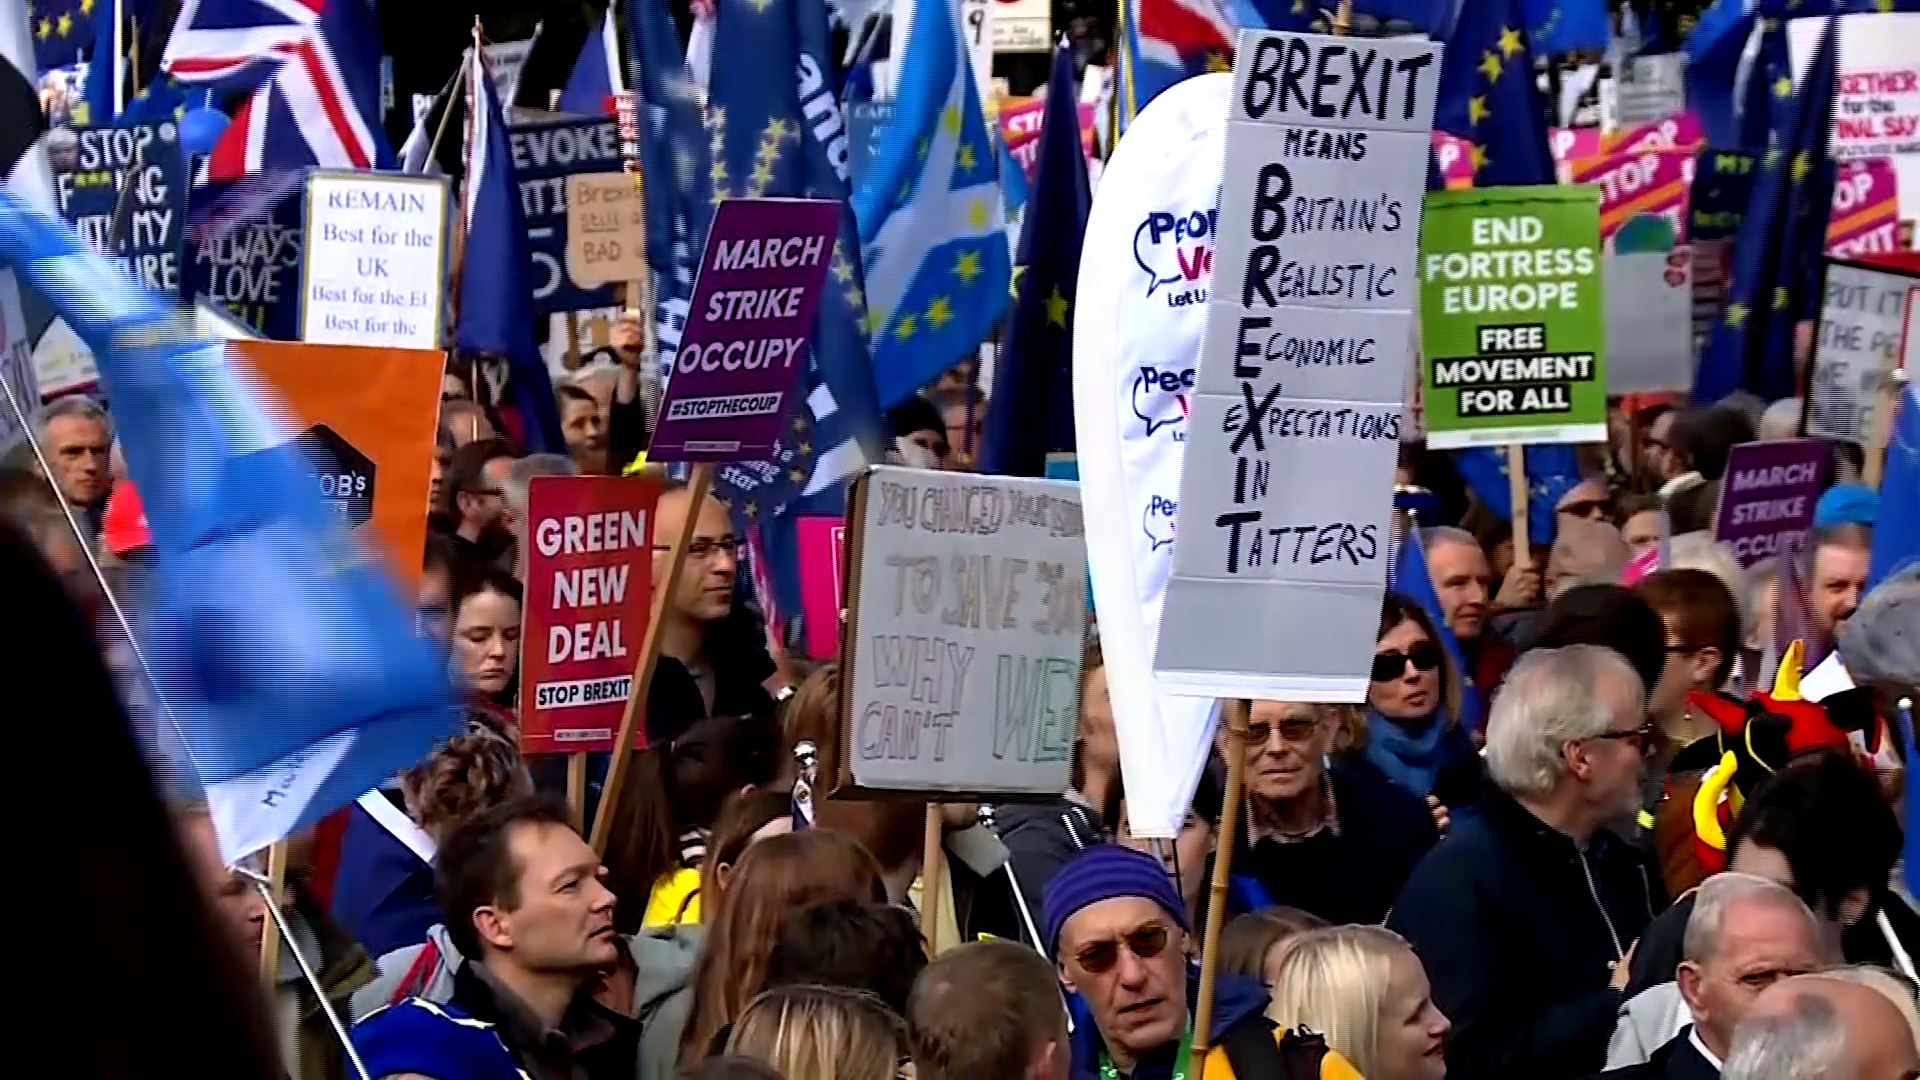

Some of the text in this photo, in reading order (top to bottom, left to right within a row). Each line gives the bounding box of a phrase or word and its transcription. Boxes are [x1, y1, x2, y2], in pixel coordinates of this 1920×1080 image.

[1243, 36, 1433, 119] BREXIT
[80, 125, 153, 169] STOP
[509, 122, 618, 168] EVOKE
[1283, 128, 1368, 160] MEANS
[329, 190, 425, 213] REMAIN
[1252, 163, 1402, 242] BRITAIN'S
[132, 208, 173, 248] MY
[324, 223, 433, 247] Best for the
[1472, 217, 1543, 246] END
[357, 257, 389, 277] UK
[583, 240, 621, 263] BAD
[713, 234, 826, 271] MARCH
[1426, 248, 1595, 283] FORTRESS
[209, 265, 281, 302] LOVE
[1242, 245, 1397, 308] REALISTIC
[312, 285, 346, 301] Best
[353, 286, 374, 304] for
[380, 288, 404, 306] the
[704, 287, 805, 322] STRIKE
[1168, 290, 1193, 307] Let
[1444, 282, 1578, 314] EUROPE
[325, 314, 417, 335] Best for the
[1480, 326, 1544, 351] FREE
[677, 337, 805, 375] OCCUPY
[1234, 317, 1376, 378] ECONOMIC
[1435, 355, 1593, 385] MOVEMENT
[672, 396, 777, 416] #STOPTHECOUP
[1461, 387, 1569, 414] FOR ALL
[1233, 456, 1270, 504] IN
[1732, 461, 1817, 492] MARCH
[877, 482, 918, 529] YOU
[920, 486, 1002, 535] CHANGED
[1730, 496, 1807, 526] STRIKE
[536, 509, 646, 556] GREEN
[1215, 510, 1378, 574] TATTERS
[552, 564, 630, 609] NEW
[885, 554, 938, 616] TO
[941, 553, 1028, 630] SAVE
[548, 619, 626, 664] DEAL
[538, 678, 631, 706] STOP BREXIT
[872, 634, 976, 716] WHY
[858, 700, 953, 761] CAN'T
